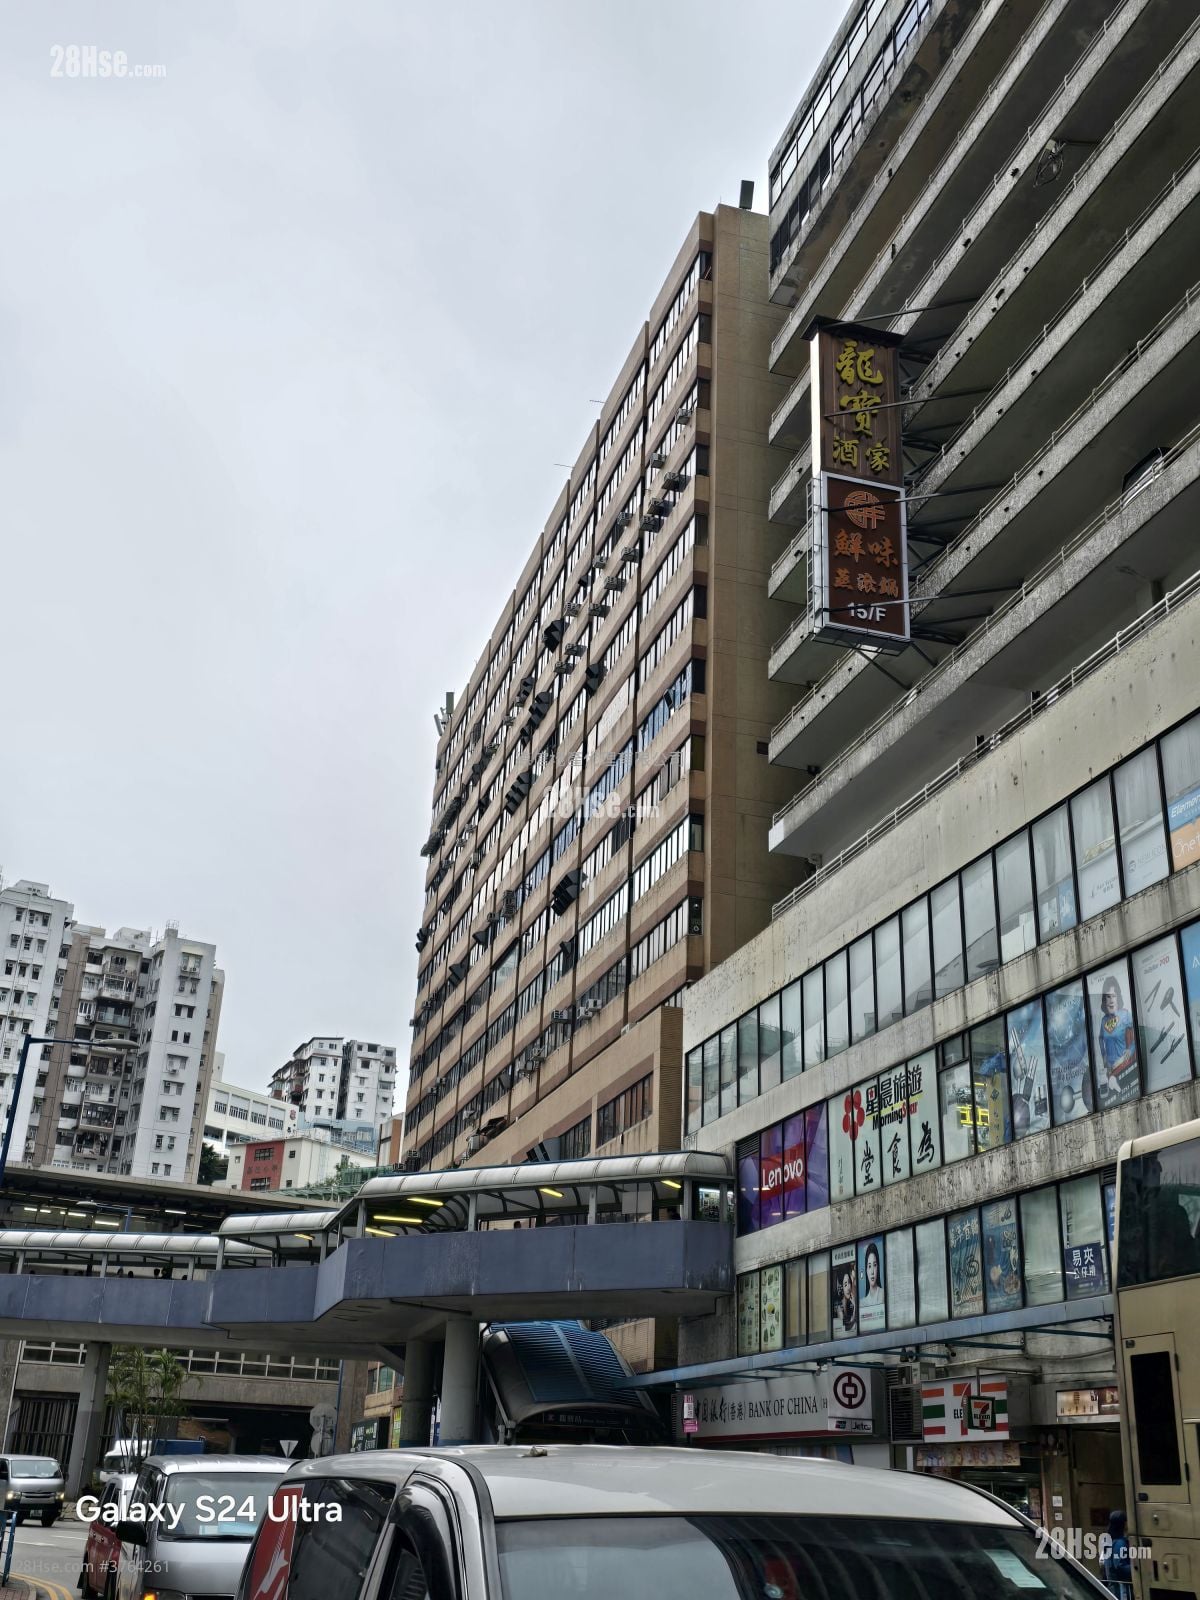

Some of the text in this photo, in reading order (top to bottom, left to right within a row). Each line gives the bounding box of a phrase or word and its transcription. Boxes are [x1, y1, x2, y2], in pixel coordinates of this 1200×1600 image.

[832, 435, 890, 471] 酒家
[847, 601, 888, 622] 15/F
[872, 1102, 918, 1131] MorningSar
[762, 1158, 804, 1188] Lenovo
[748, 1401, 772, 1419] BANK
[773, 1398, 785, 1416] OF
[787, 1396, 818, 1415] CHINA
